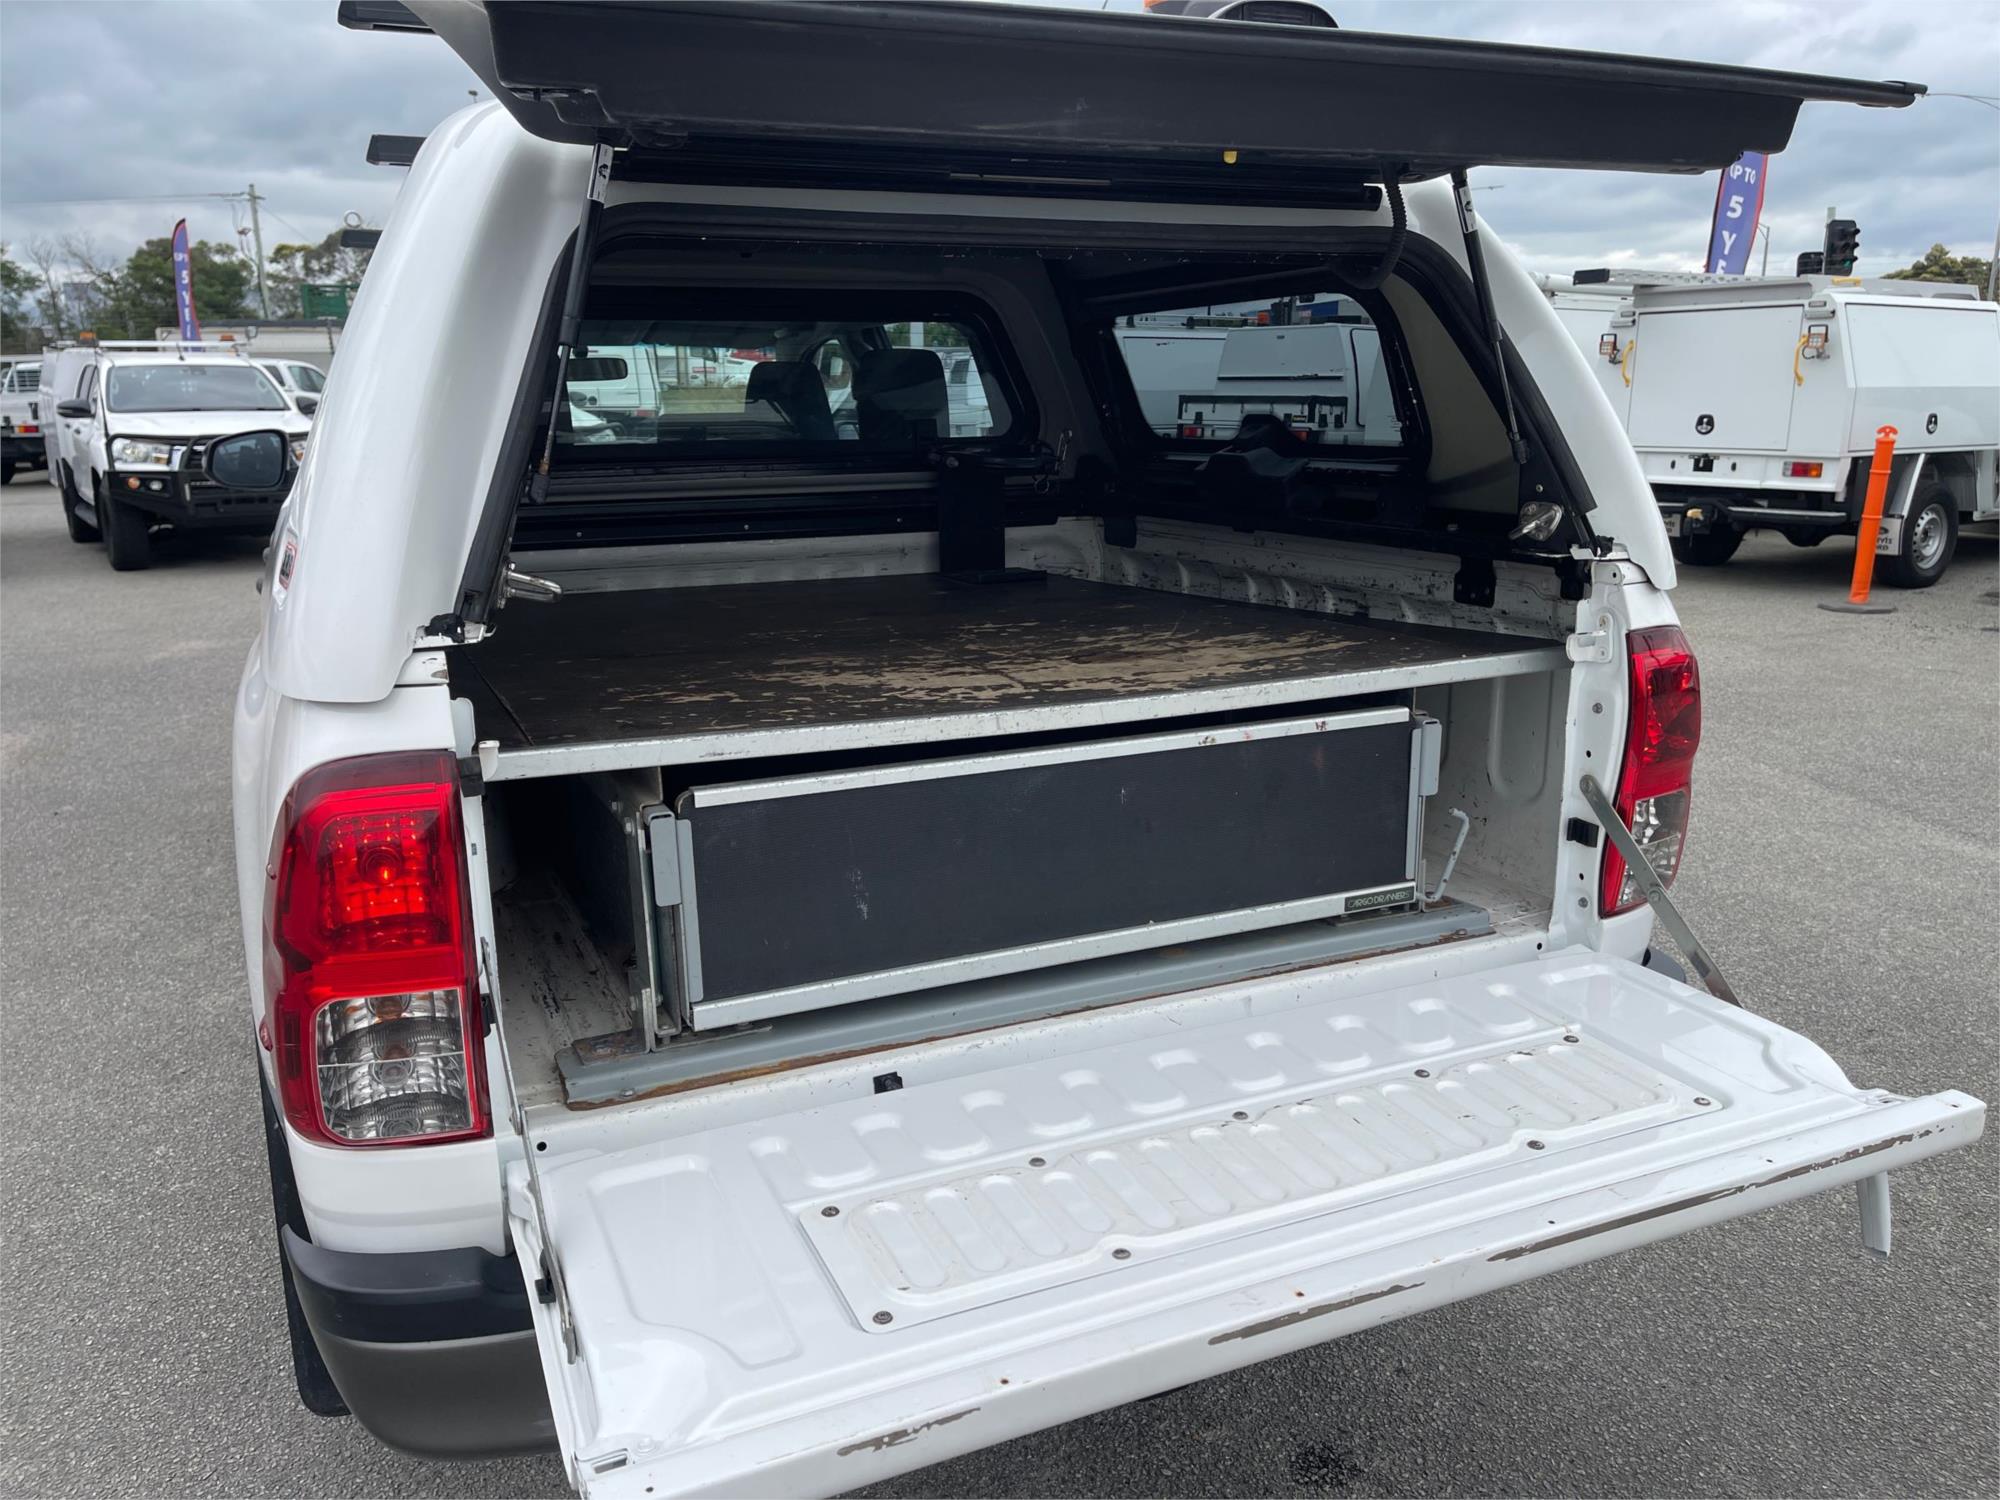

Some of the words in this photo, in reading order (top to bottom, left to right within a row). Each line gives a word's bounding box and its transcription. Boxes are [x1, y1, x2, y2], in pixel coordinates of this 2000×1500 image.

[1744, 167, 1756, 184] TO
[1726, 195, 1744, 219] 5
[181, 270, 189, 285] 5
